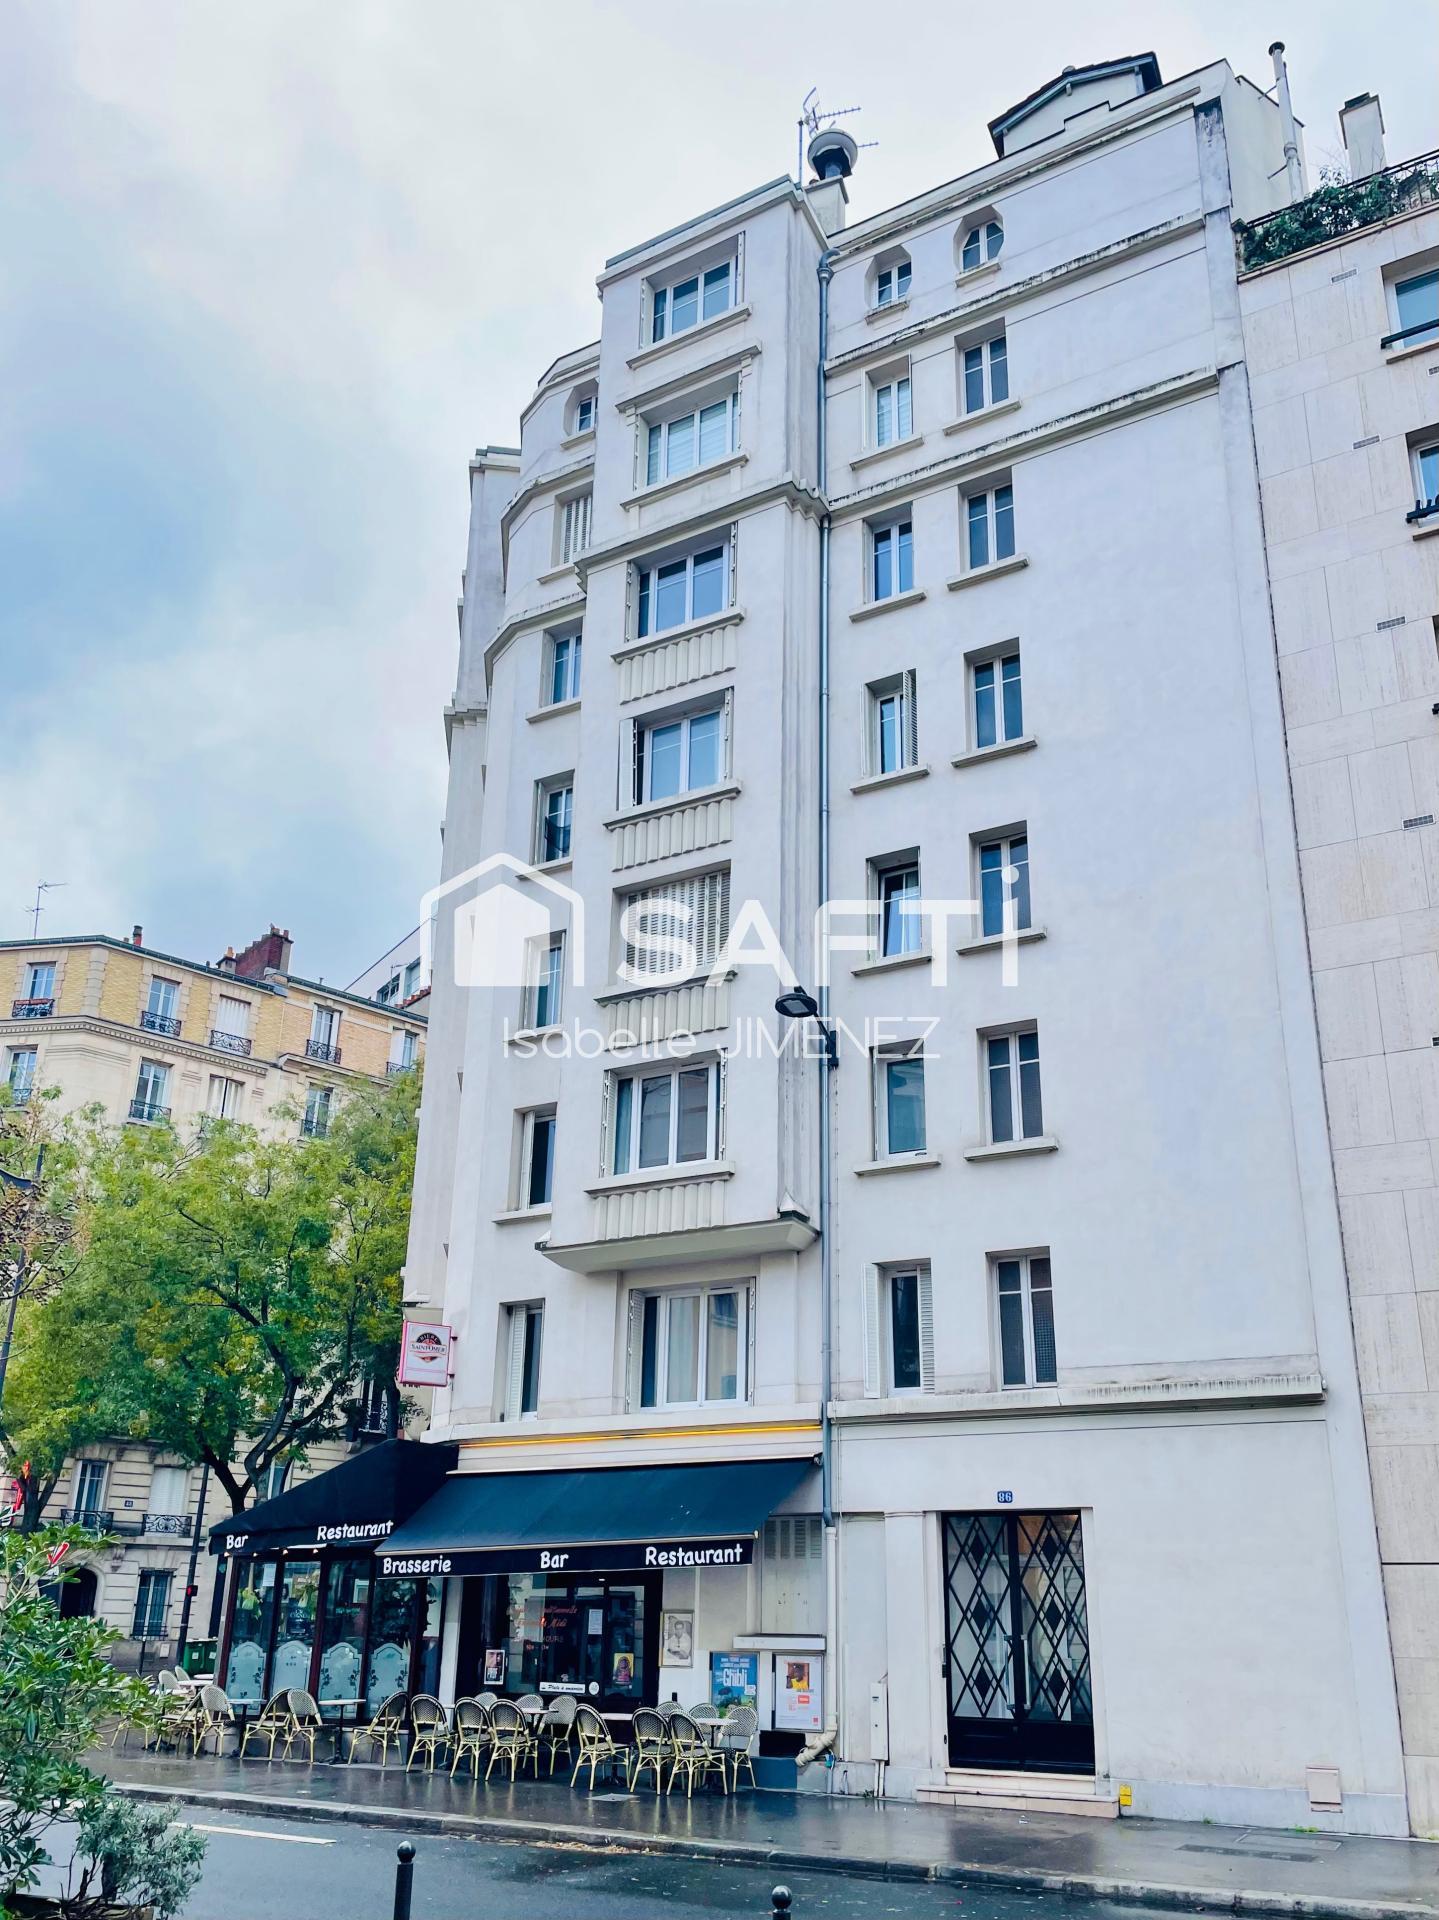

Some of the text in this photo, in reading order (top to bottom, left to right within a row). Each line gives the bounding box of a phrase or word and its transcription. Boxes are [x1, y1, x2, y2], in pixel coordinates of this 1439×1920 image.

[998, 1491, 1012, 1503] 86
[226, 1520, 393, 1549] Bar Restaurant
[382, 1543, 743, 1574] Brasserie Bar Restaurant
